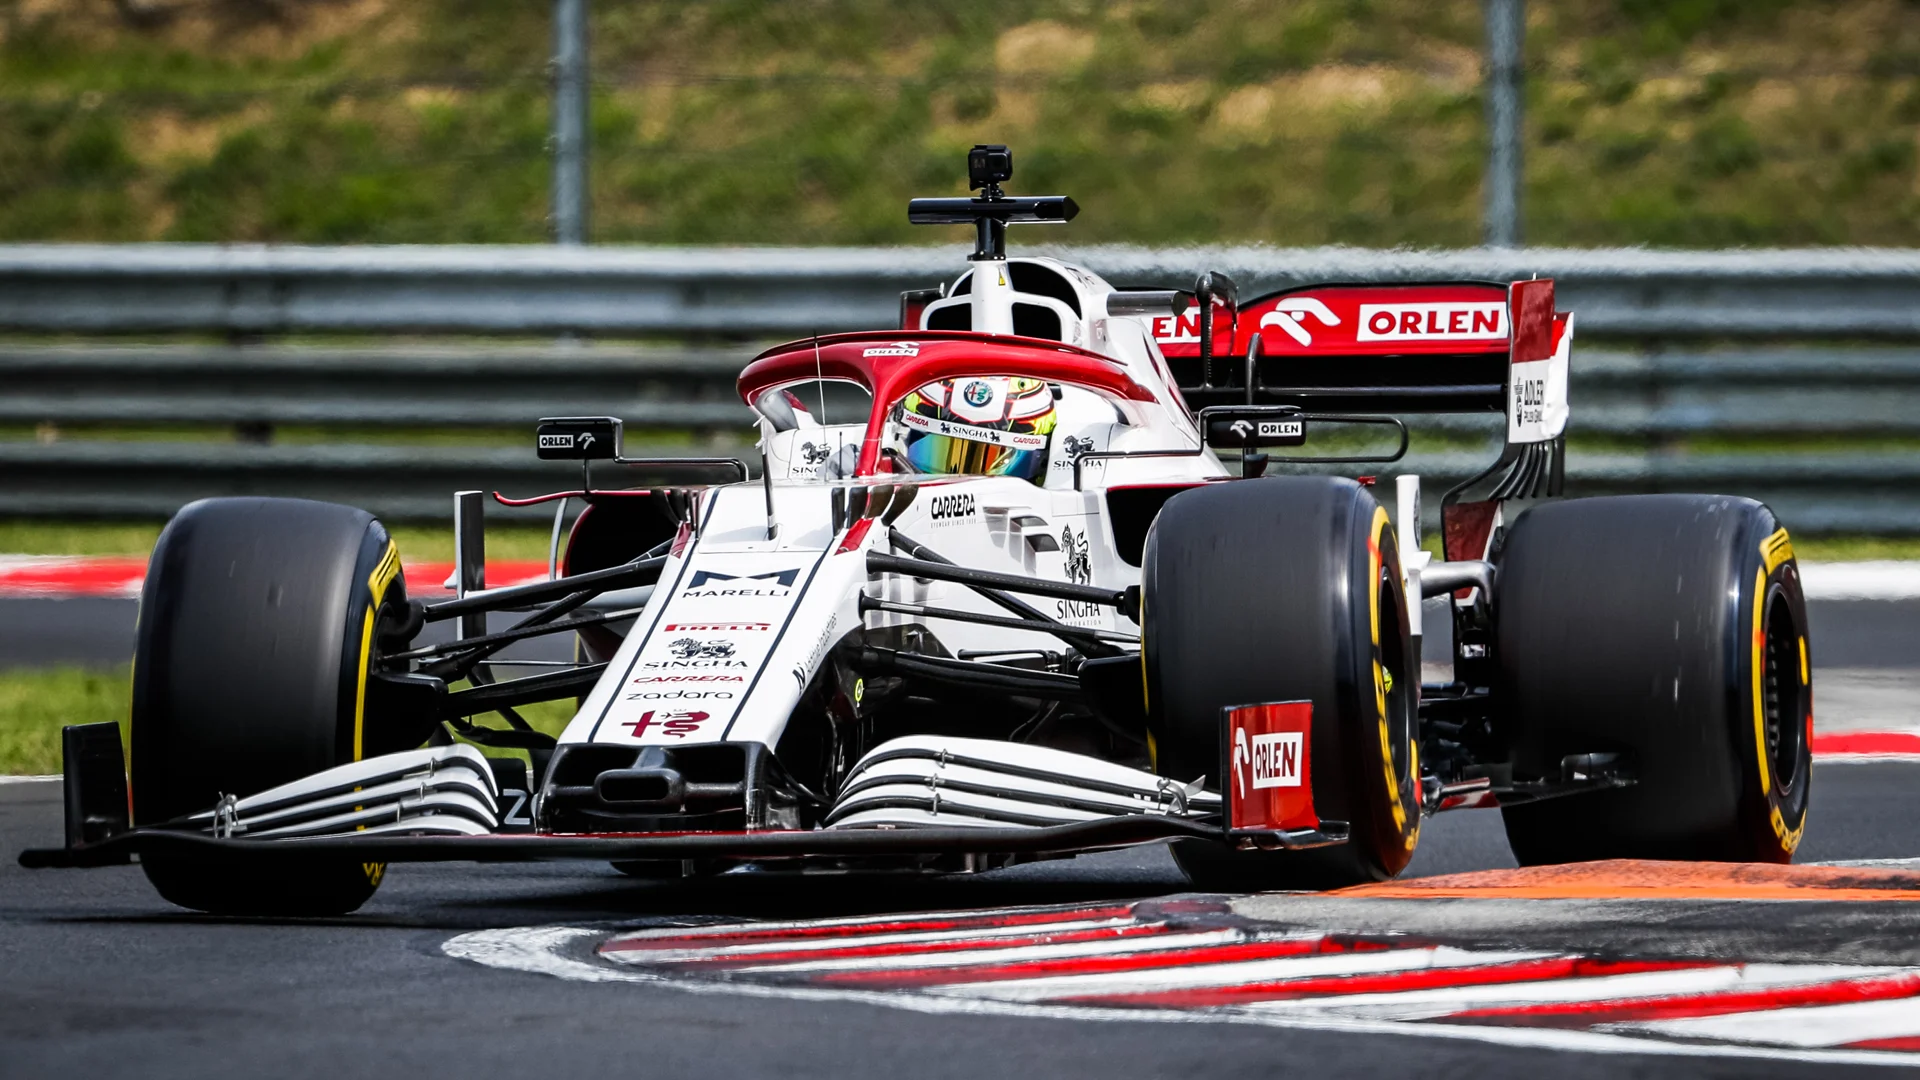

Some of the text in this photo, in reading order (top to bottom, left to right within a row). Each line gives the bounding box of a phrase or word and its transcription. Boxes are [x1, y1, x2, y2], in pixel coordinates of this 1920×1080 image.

[1368, 310, 1499, 335] ORLEN
[905, 413, 930, 427] CARRERA
[952, 426, 988, 439] SINGHA
[1261, 424, 1299, 434] ORLEN
[541, 437, 571, 446] ORLEN
[1012, 436, 1041, 445] CARRERA
[1053, 460, 1102, 468] SINHA
[931, 493, 976, 520] CARRERA
[682, 589, 790, 598] MARELLI
[1057, 600, 1101, 619] SINGHA
[664, 622, 771, 632] PIRELLI
[643, 660, 748, 669] SINGHA
[633, 675, 744, 683] CARRERA
[626, 690, 733, 700] zadara
[1255, 741, 1297, 780] ORLEN
